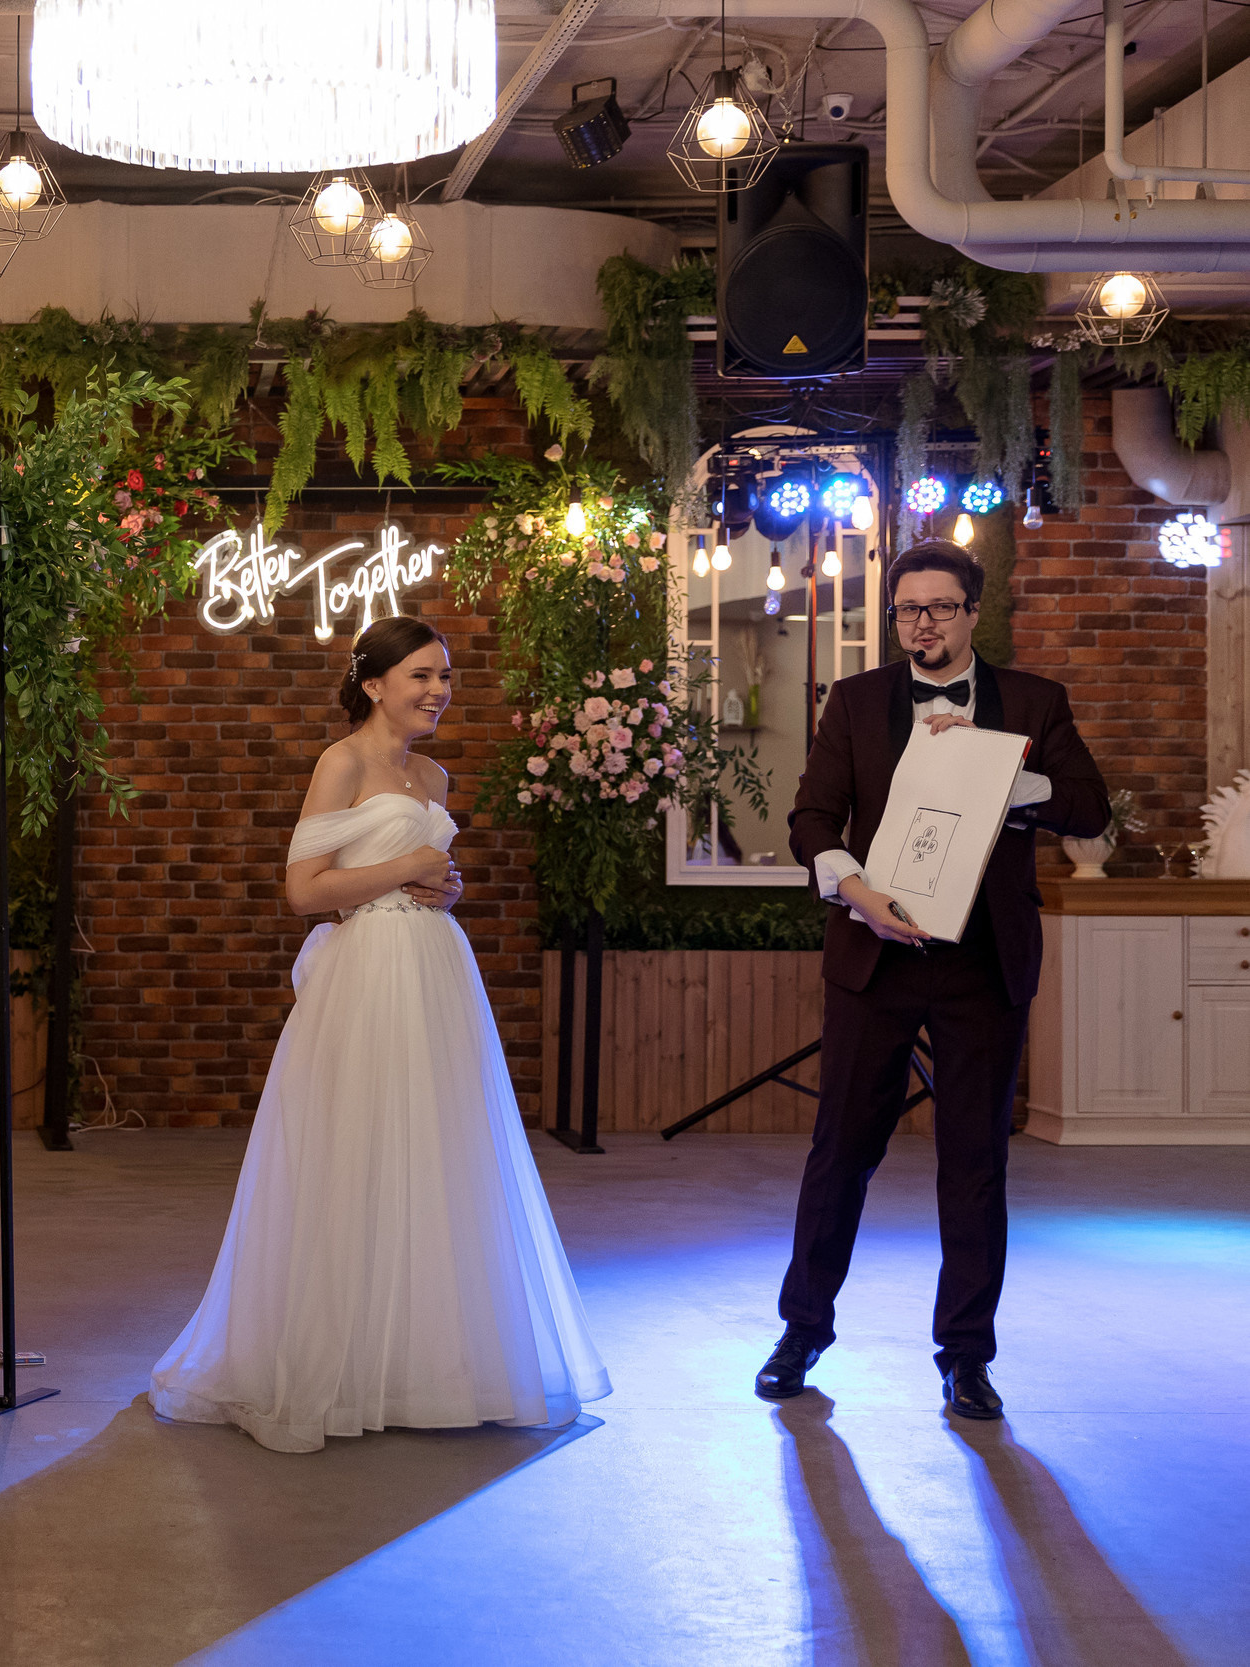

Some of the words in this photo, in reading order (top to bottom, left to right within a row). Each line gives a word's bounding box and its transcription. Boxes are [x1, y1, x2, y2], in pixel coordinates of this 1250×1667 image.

[194, 523, 300, 630] Better
[286, 525, 445, 636] Together
[914, 812, 923, 825] A
